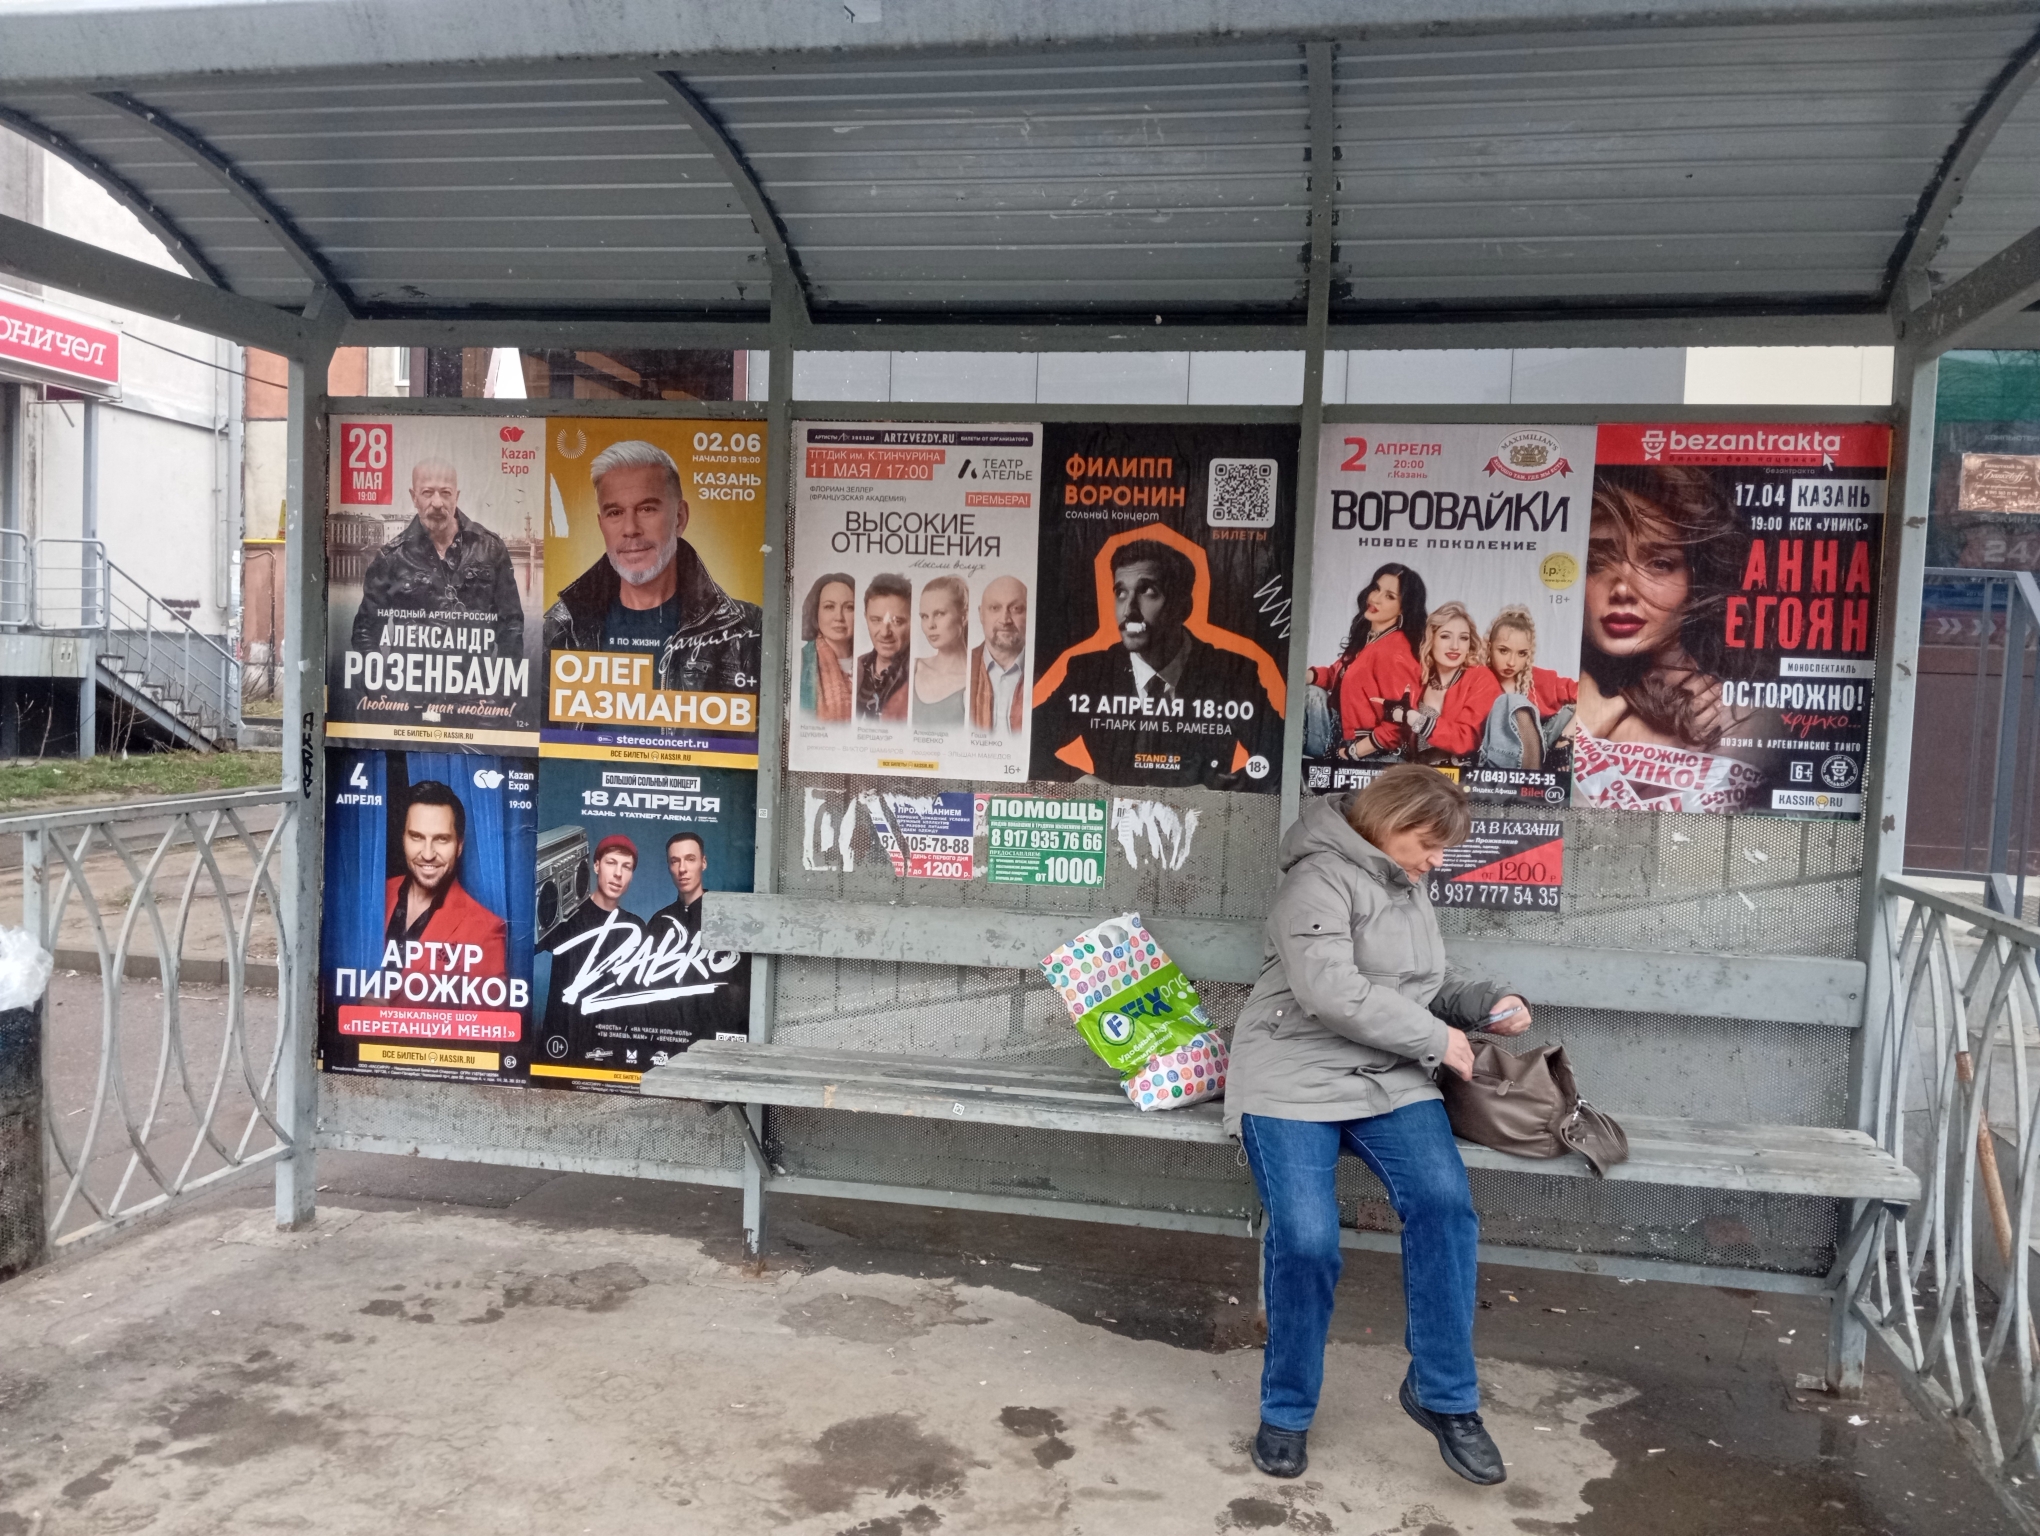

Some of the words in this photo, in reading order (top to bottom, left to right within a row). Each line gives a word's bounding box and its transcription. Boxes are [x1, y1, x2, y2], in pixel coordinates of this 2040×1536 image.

[692, 432, 761, 453] 02.06
[883, 431, 956, 444] ARTZVEZDY.RU
[1500, 433, 1559, 452] MAXIMILIAN'S
[348, 427, 387, 470] 28
[501, 447, 536, 460] Kazan
[1340, 436, 1368, 472] 2
[1374, 442, 1442, 456] АПРЕЛЯ
[692, 454, 729, 464] НАЧАЛО
[738, 456, 761, 464] 19:00
[868, 451, 941, 462] К.ТИНЧУРИНА
[982, 458, 1024, 470] ТЕАТР
[1393, 459, 1425, 469] 20:00
[501, 462, 530, 477] Expo
[810, 463, 826, 477] 11
[832, 463, 871, 478] МАЯ
[886, 465, 929, 479] 17:00
[1065, 452, 1173, 481] ФИЛИПП
[352, 471, 383, 490] МАЯ
[693, 472, 762, 486] КАЗАНЬ
[981, 469, 1033, 481] АТЕЛЬЕ
[1387, 470, 1428, 480] г.Казань
[357, 491, 377, 502] 19:00
[698, 488, 756, 502] ЭКСПО
[809, 485, 845, 493] ФЛОРИАН
[1065, 484, 1186, 507] ВОРОНИН
[1735, 483, 1786, 507] 17.04
[1797, 485, 1871, 508] КАЗАНЬ
[809, 493, 864, 502] (ФРАНЦУЗСКАЯ
[865, 494, 907, 503] АКАДЕМИЯ)
[967, 494, 1028, 505] ПРЕМЬЕРА!
[1065, 509, 1109, 520] сольный
[1111, 510, 1160, 523] концерт
[1330, 489, 1571, 533] ВОРОВАЙКИ
[845, 510, 976, 535] ВЫСОКИЕ
[1751, 516, 1782, 531] 19:00
[1789, 517, 1813, 531] КСК
[1816, 517, 1869, 532] «УНИКС»
[1212, 528, 1268, 541] БИЛЕТЫ
[831, 531, 1000, 558] ОТНОШЕНИЯ
[1358, 537, 1418, 549] НОВОЕ
[1427, 538, 1537, 551] ПОКОЛЕНИЕ
[1742, 539, 1871, 594] АННА
[1549, 594, 1570, 605] 18+
[377, 607, 426, 619] НАРОДНЫЙ
[428, 610, 461, 620] АРТИСТ
[463, 612, 498, 622] РОССИИ
[1725, 596, 1871, 652] ЕГОЯН
[379, 624, 495, 654] АЛЕКСАНДР
[344, 650, 530, 698] РОЗЕНБАУМ
[554, 654, 650, 686] ОЛЕГ
[1787, 662, 1857, 674] МОНОСПЕКТАКЛЬ
[734, 672, 757, 688] 6+
[1722, 681, 1864, 711] ОСТОРОЖНО!
[356, 695, 410, 712] Любить
[457, 699, 518, 717] любить!
[554, 688, 751, 727] ГАЗМАНОВ
[1068, 694, 1090, 713] 12
[1096, 695, 1185, 717] АПРЕЛЯ
[1192, 699, 1254, 720] 18:00
[516, 720, 530, 728] 12+
[1090, 718, 1136, 731] IT-ПАРК
[1139, 720, 1159, 732] ИМ
[1162, 721, 1173, 733] Б.
[1176, 722, 1232, 736] РАМЕЕВА
[393, 728, 406, 737] ВСЕ
[407, 729, 433, 739] БИЛЕТЫ
[616, 734, 709, 749] stereoconcert.ru
[970, 739, 1003, 748] КУЦЕНКО
[1720, 737, 1753, 748] ПОЭЗИЯ
[1767, 739, 1831, 751] АРГЕНТИНСКОЕ
[1834, 742, 1861, 752] ТАНГО
[610, 750, 622, 758] ВСЕ
[623, 751, 650, 760] БИЛЕТЫ
[1134, 753, 1167, 763] STAND
[1003, 764, 1021, 775] 16+
[1134, 762, 1154, 770] CLUB
[1155, 763, 1181, 771] KAZAN
[1248, 760, 1268, 773] 18+
[1795, 765, 1813, 779] 6+
[350, 762, 369, 790] 4
[508, 770, 534, 781] Kazan
[605, 773, 637, 786] БОЛЬШОЙ
[637, 775, 669, 787] СОЛЬНЫЙ
[669, 778, 698, 789] КОНЦЕРТ
[1466, 769, 1480, 782] +7
[1480, 770, 1508, 783] (843)
[1509, 771, 1556, 786] 512-25-35
[508, 781, 530, 793] Expo
[1472, 786, 1494, 794] Яндекс
[1495, 787, 1517, 795] Афиша
[336, 793, 383, 806] АПРЕЛЯ
[508, 800, 532, 810] 19:00
[581, 790, 610, 806] 18
[613, 793, 721, 813] АПРЕЛЯ
[581, 809, 616, 817] КАЗАНЬ
[624, 811, 662, 820] TATNEFT
[662, 813, 693, 822] ARENA
[991, 798, 1104, 824] ПОМОЩЬ
[1488, 821, 1500, 834] В
[1502, 822, 1561, 836] КАЗАНИ
[991, 828, 1001, 846] 8
[1003, 829, 1028, 848] 917
[1030, 830, 1060, 849] 935
[1062, 831, 1080, 850] 76
[1082, 832, 1103, 851] 66
[923, 861, 963, 878] 1200
[1499, 861, 1547, 883] 1200
[1429, 880, 1440, 901] 8
[1444, 883, 1474, 905] 937
[1479, 884, 1509, 905] 777
[1513, 885, 1533, 906] 54
[1538, 886, 1559, 906] 35
[380, 939, 484, 973] АРТУР
[335, 967, 530, 1008] ПИРОЖКОВ
[379, 1009, 453, 1022] МУЗЫКАЛЬНОЕ
[455, 1013, 478, 1022] ШОУ
[343, 1019, 452, 1037] «ПЕРЕТАНЦУЙ
[457, 1024, 516, 1039] МЕНЯ!»
[382, 1050, 396, 1059] ВСЕ
[397, 1051, 427, 1061] БИЛЕТЫ
[439, 1054, 476, 1065] KASSIR.RU
